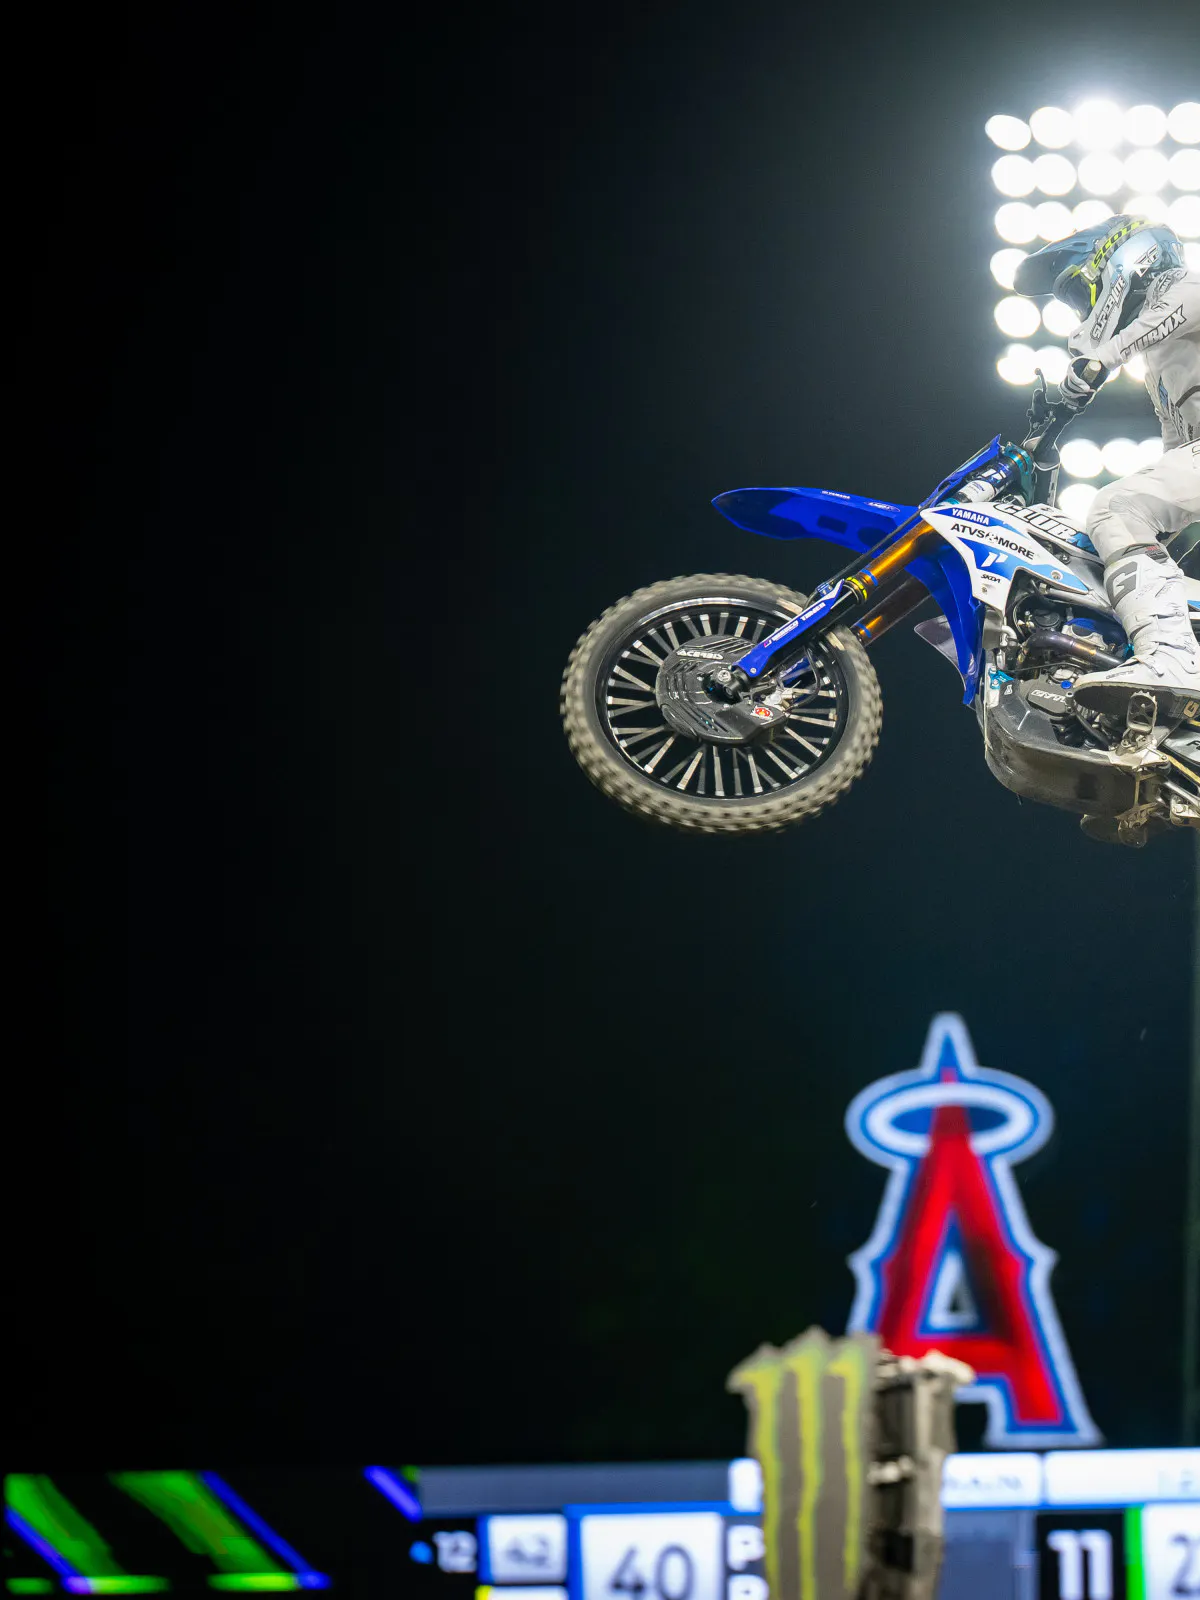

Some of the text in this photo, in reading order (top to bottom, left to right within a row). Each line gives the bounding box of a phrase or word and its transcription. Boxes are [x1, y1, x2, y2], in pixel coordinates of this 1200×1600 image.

[952, 508, 990, 526] YAMAHA
[607, 1542, 696, 1600] 40
[1046, 1529, 1113, 1600] 11
